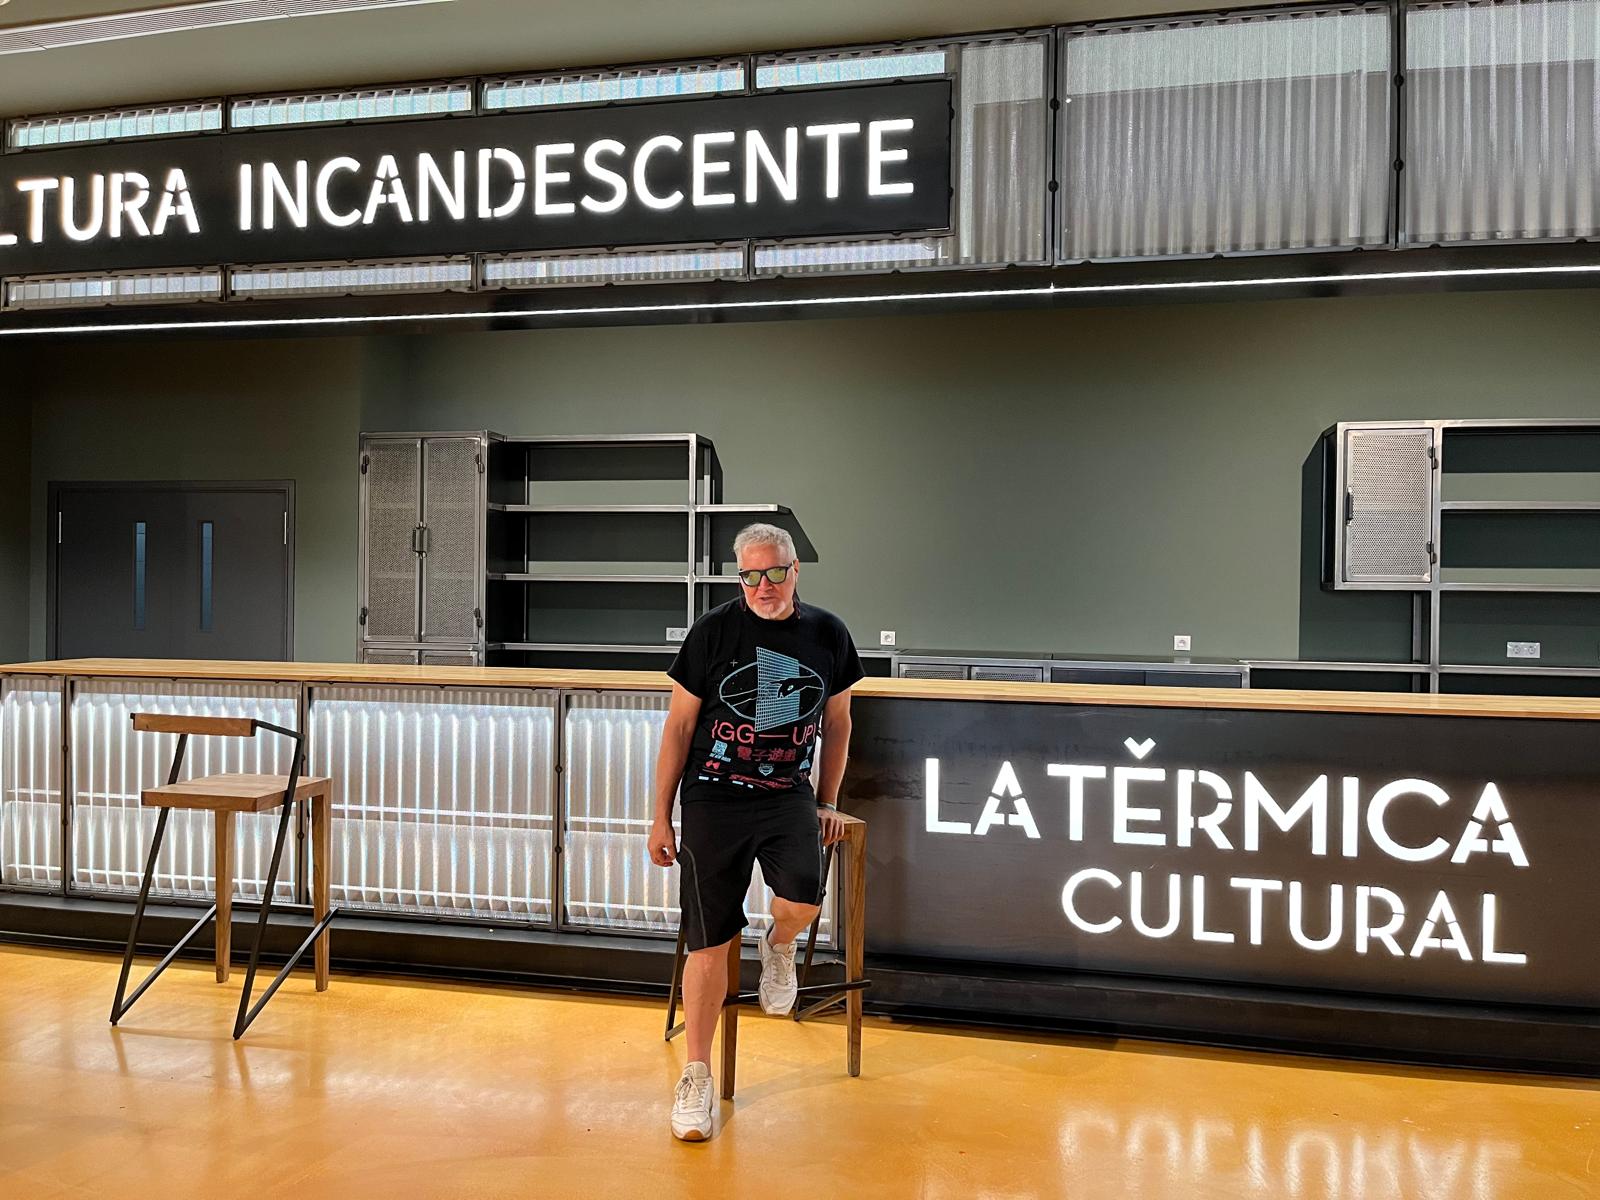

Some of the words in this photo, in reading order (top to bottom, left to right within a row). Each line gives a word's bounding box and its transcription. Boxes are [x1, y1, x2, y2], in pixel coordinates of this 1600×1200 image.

[0, 174, 202, 246] TURA
[237, 118, 914, 231] INCANDESCENTE
[1061, 867, 1527, 965] CULTURAL
